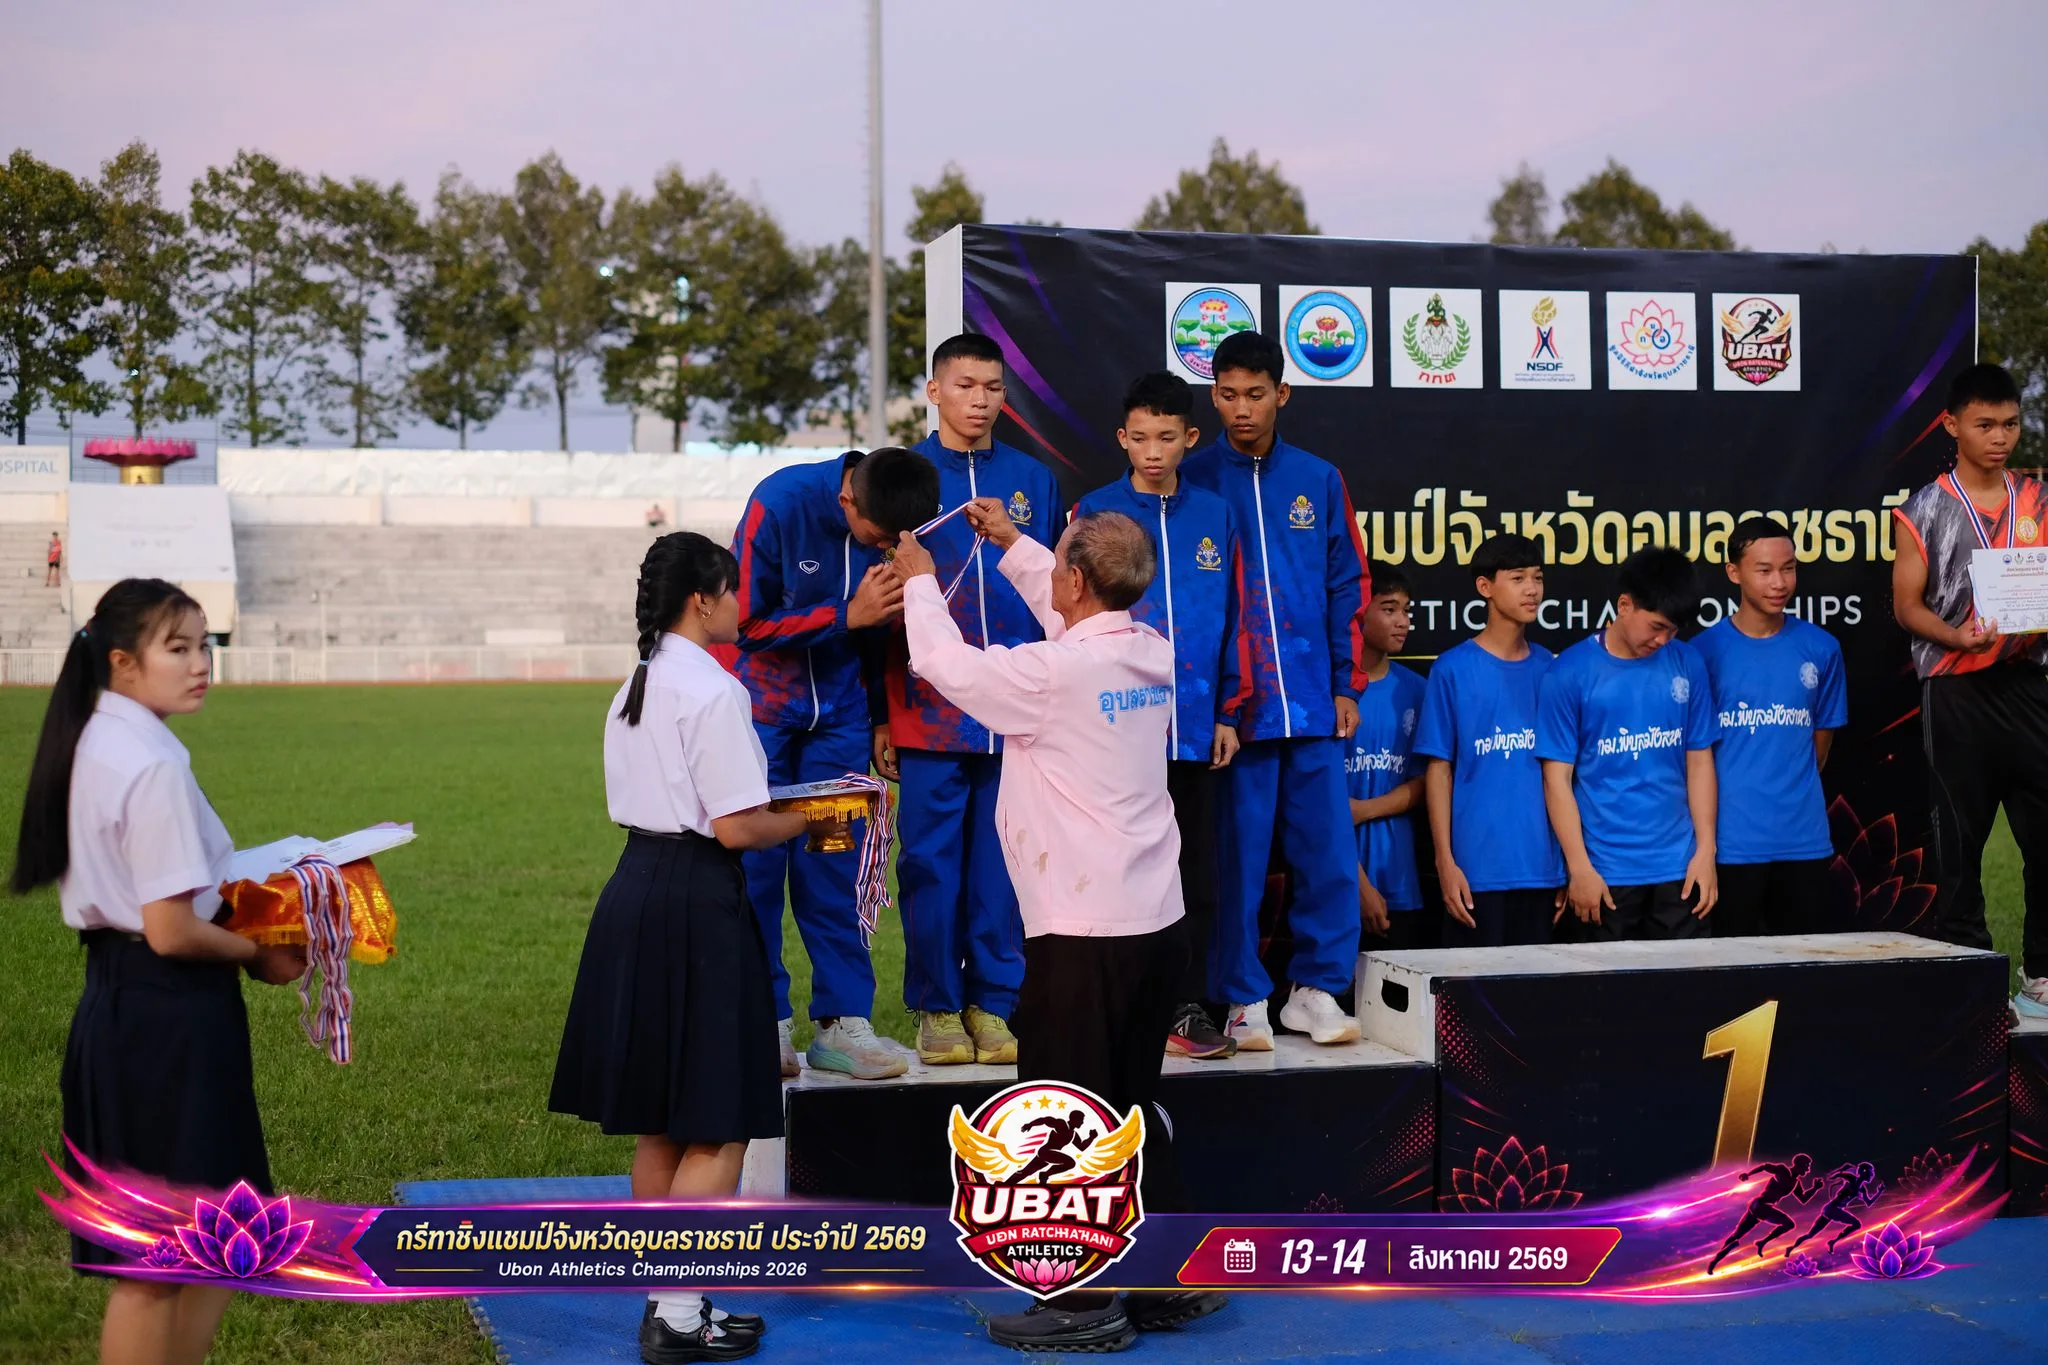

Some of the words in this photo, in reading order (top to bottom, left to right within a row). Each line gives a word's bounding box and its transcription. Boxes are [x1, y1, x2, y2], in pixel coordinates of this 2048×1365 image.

[1728, 343, 1787, 360] UBAT
[1527, 362, 1563, 371] NSDF
[0, 460, 58, 474] SPITAL
[1703, 1000, 1778, 1174] 1
